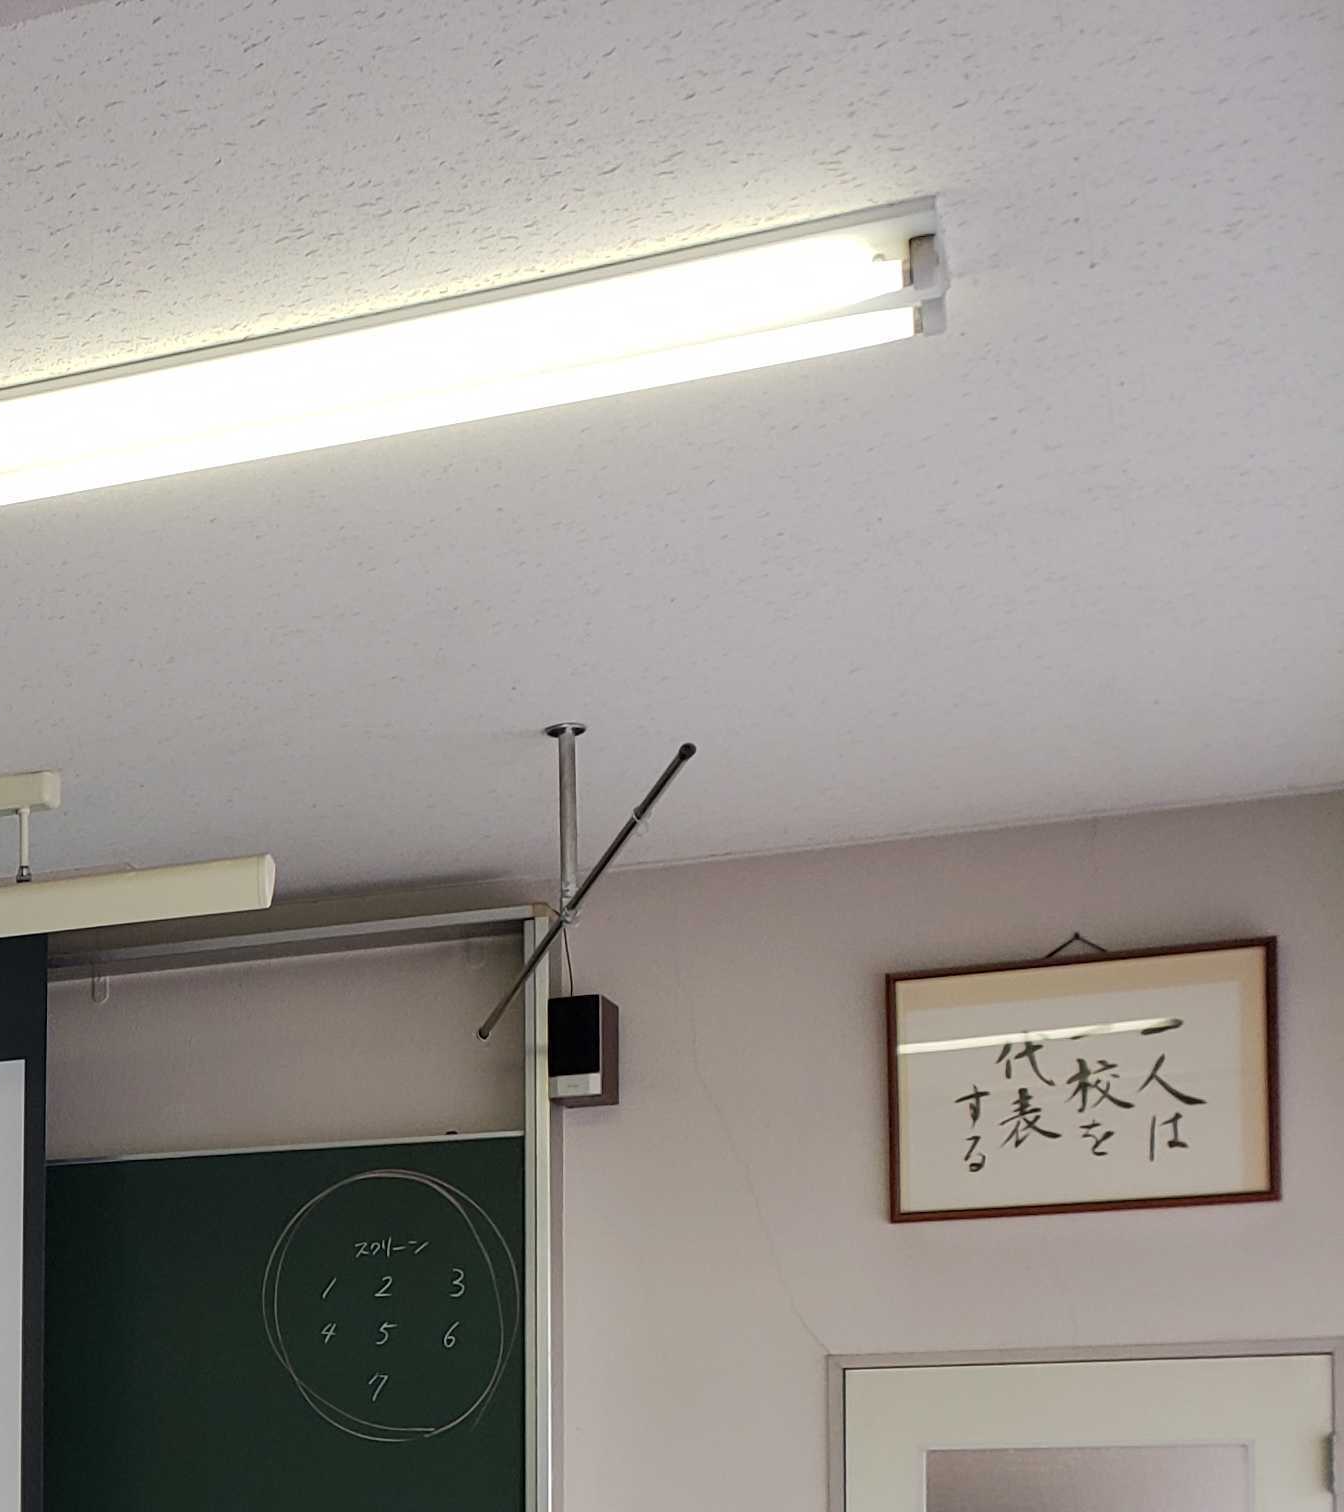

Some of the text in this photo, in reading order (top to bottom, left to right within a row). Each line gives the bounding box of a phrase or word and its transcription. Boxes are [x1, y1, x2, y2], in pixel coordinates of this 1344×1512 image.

[954, 1084, 990, 1172] する
[354, 1237, 430, 1258] スクリーン
[321, 1268, 465, 1300] 1 2 3
[321, 1321, 460, 1348] 4 5 6
[368, 1373, 389, 1402] 7
